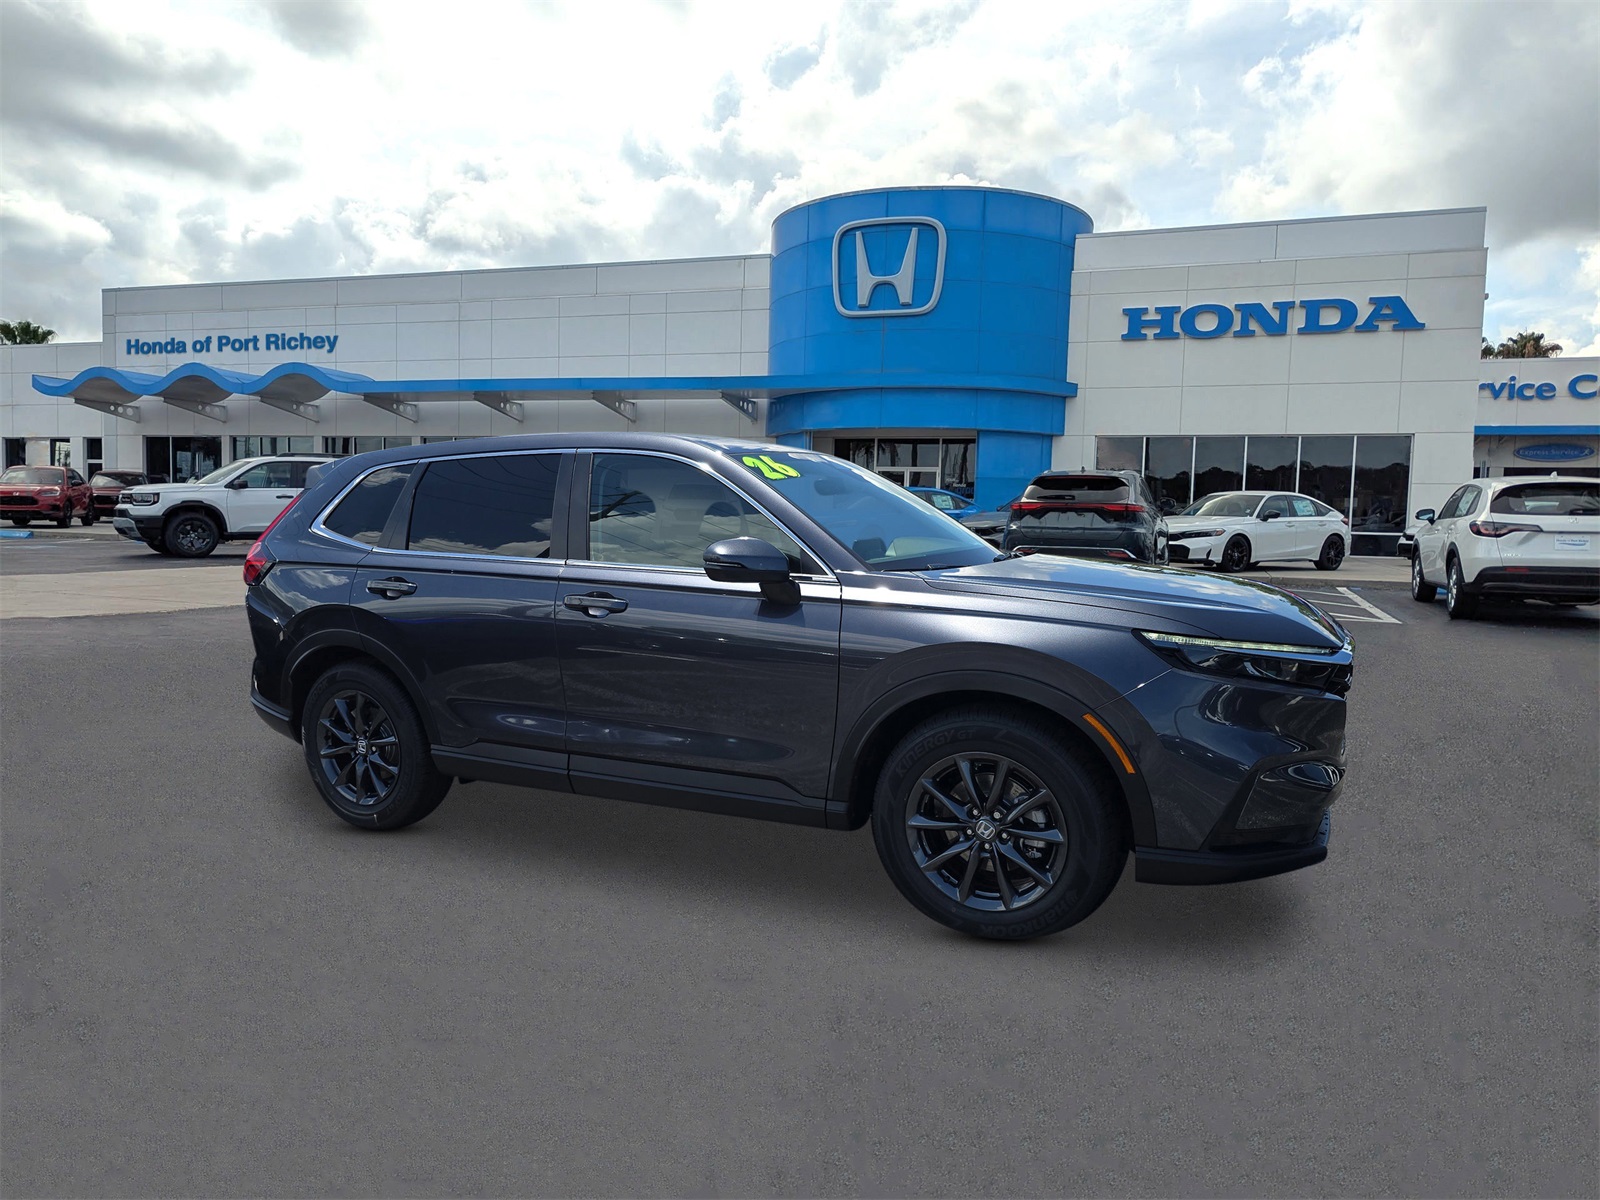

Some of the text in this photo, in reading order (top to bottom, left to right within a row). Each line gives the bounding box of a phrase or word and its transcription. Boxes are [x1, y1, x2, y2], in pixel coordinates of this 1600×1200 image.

[1121, 295, 1426, 340] HONDA
[126, 332, 339, 355] Honda of Port Richey
[1568, 374, 1600, 400] C
[742, 455, 801, 480] 26
[895, 729, 977, 777] KINERGY GT
